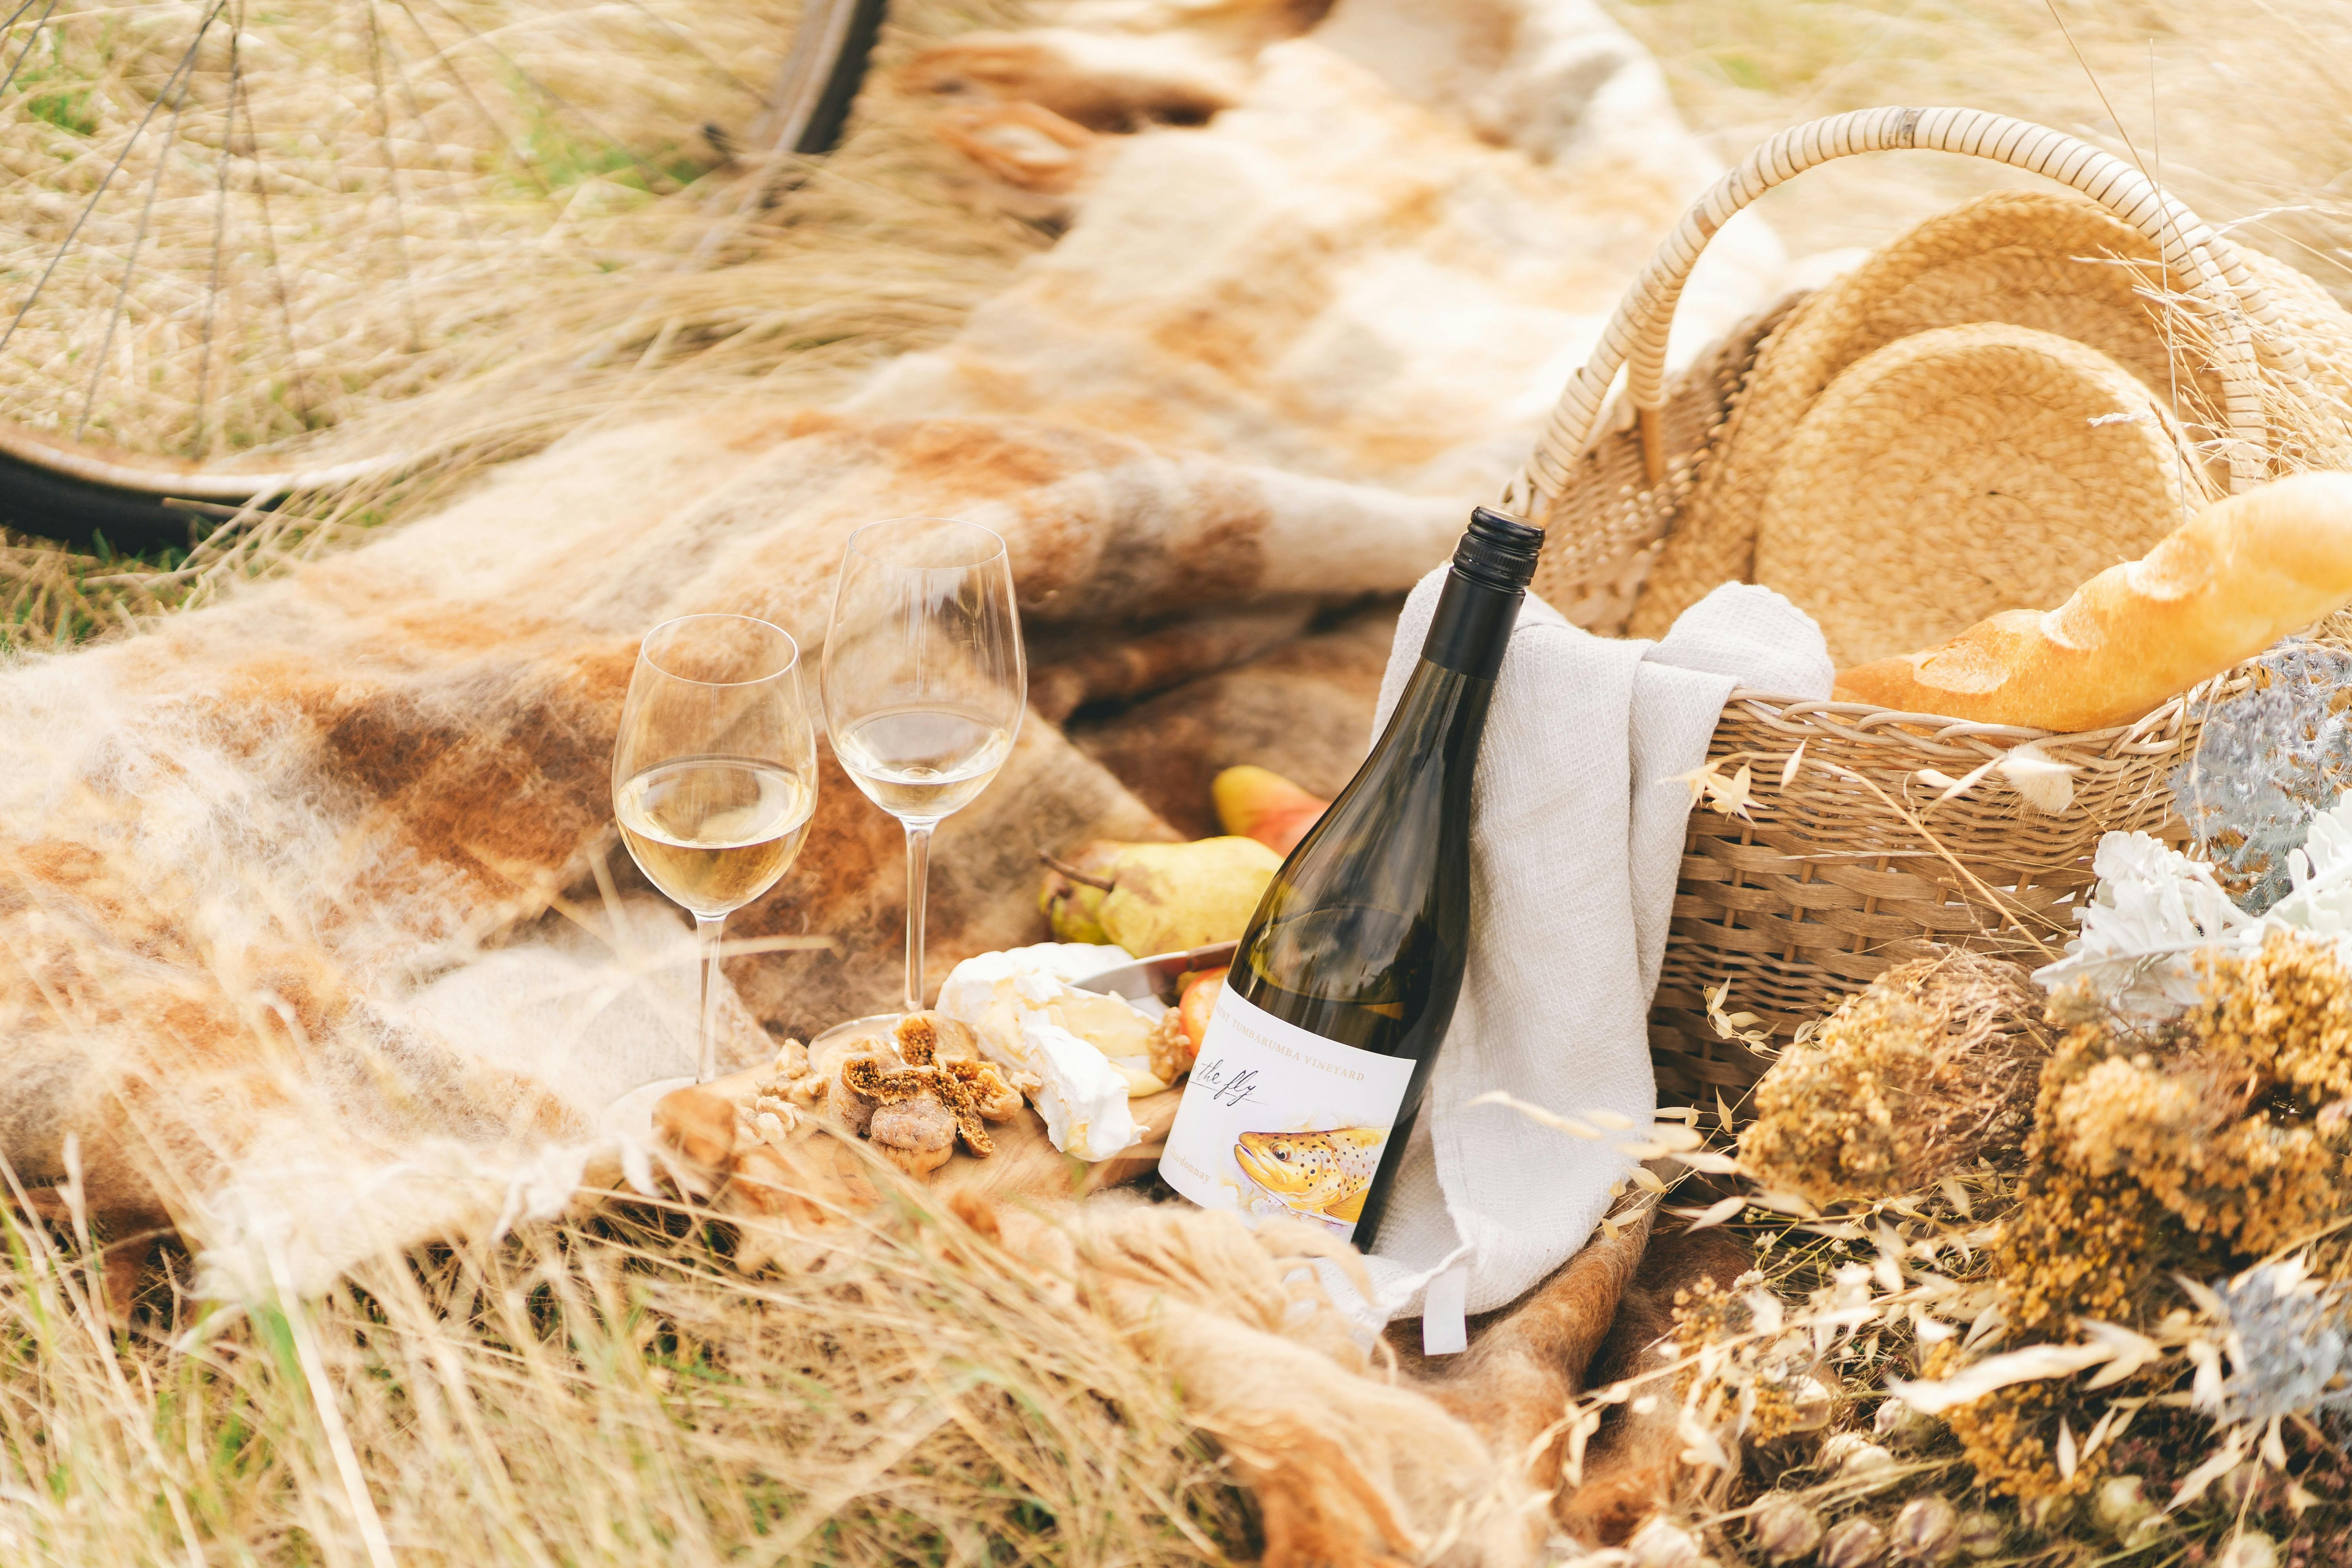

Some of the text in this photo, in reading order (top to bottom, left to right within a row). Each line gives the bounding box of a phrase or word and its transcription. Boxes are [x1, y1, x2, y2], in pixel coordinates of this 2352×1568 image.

[1232, 1019, 1300, 1060] TUMBARUMBA
[1304, 1055, 1365, 1082] VINEYARD
[1196, 1060, 1258, 1107] the fly
[1169, 1144, 1210, 1180] Chardonnay
